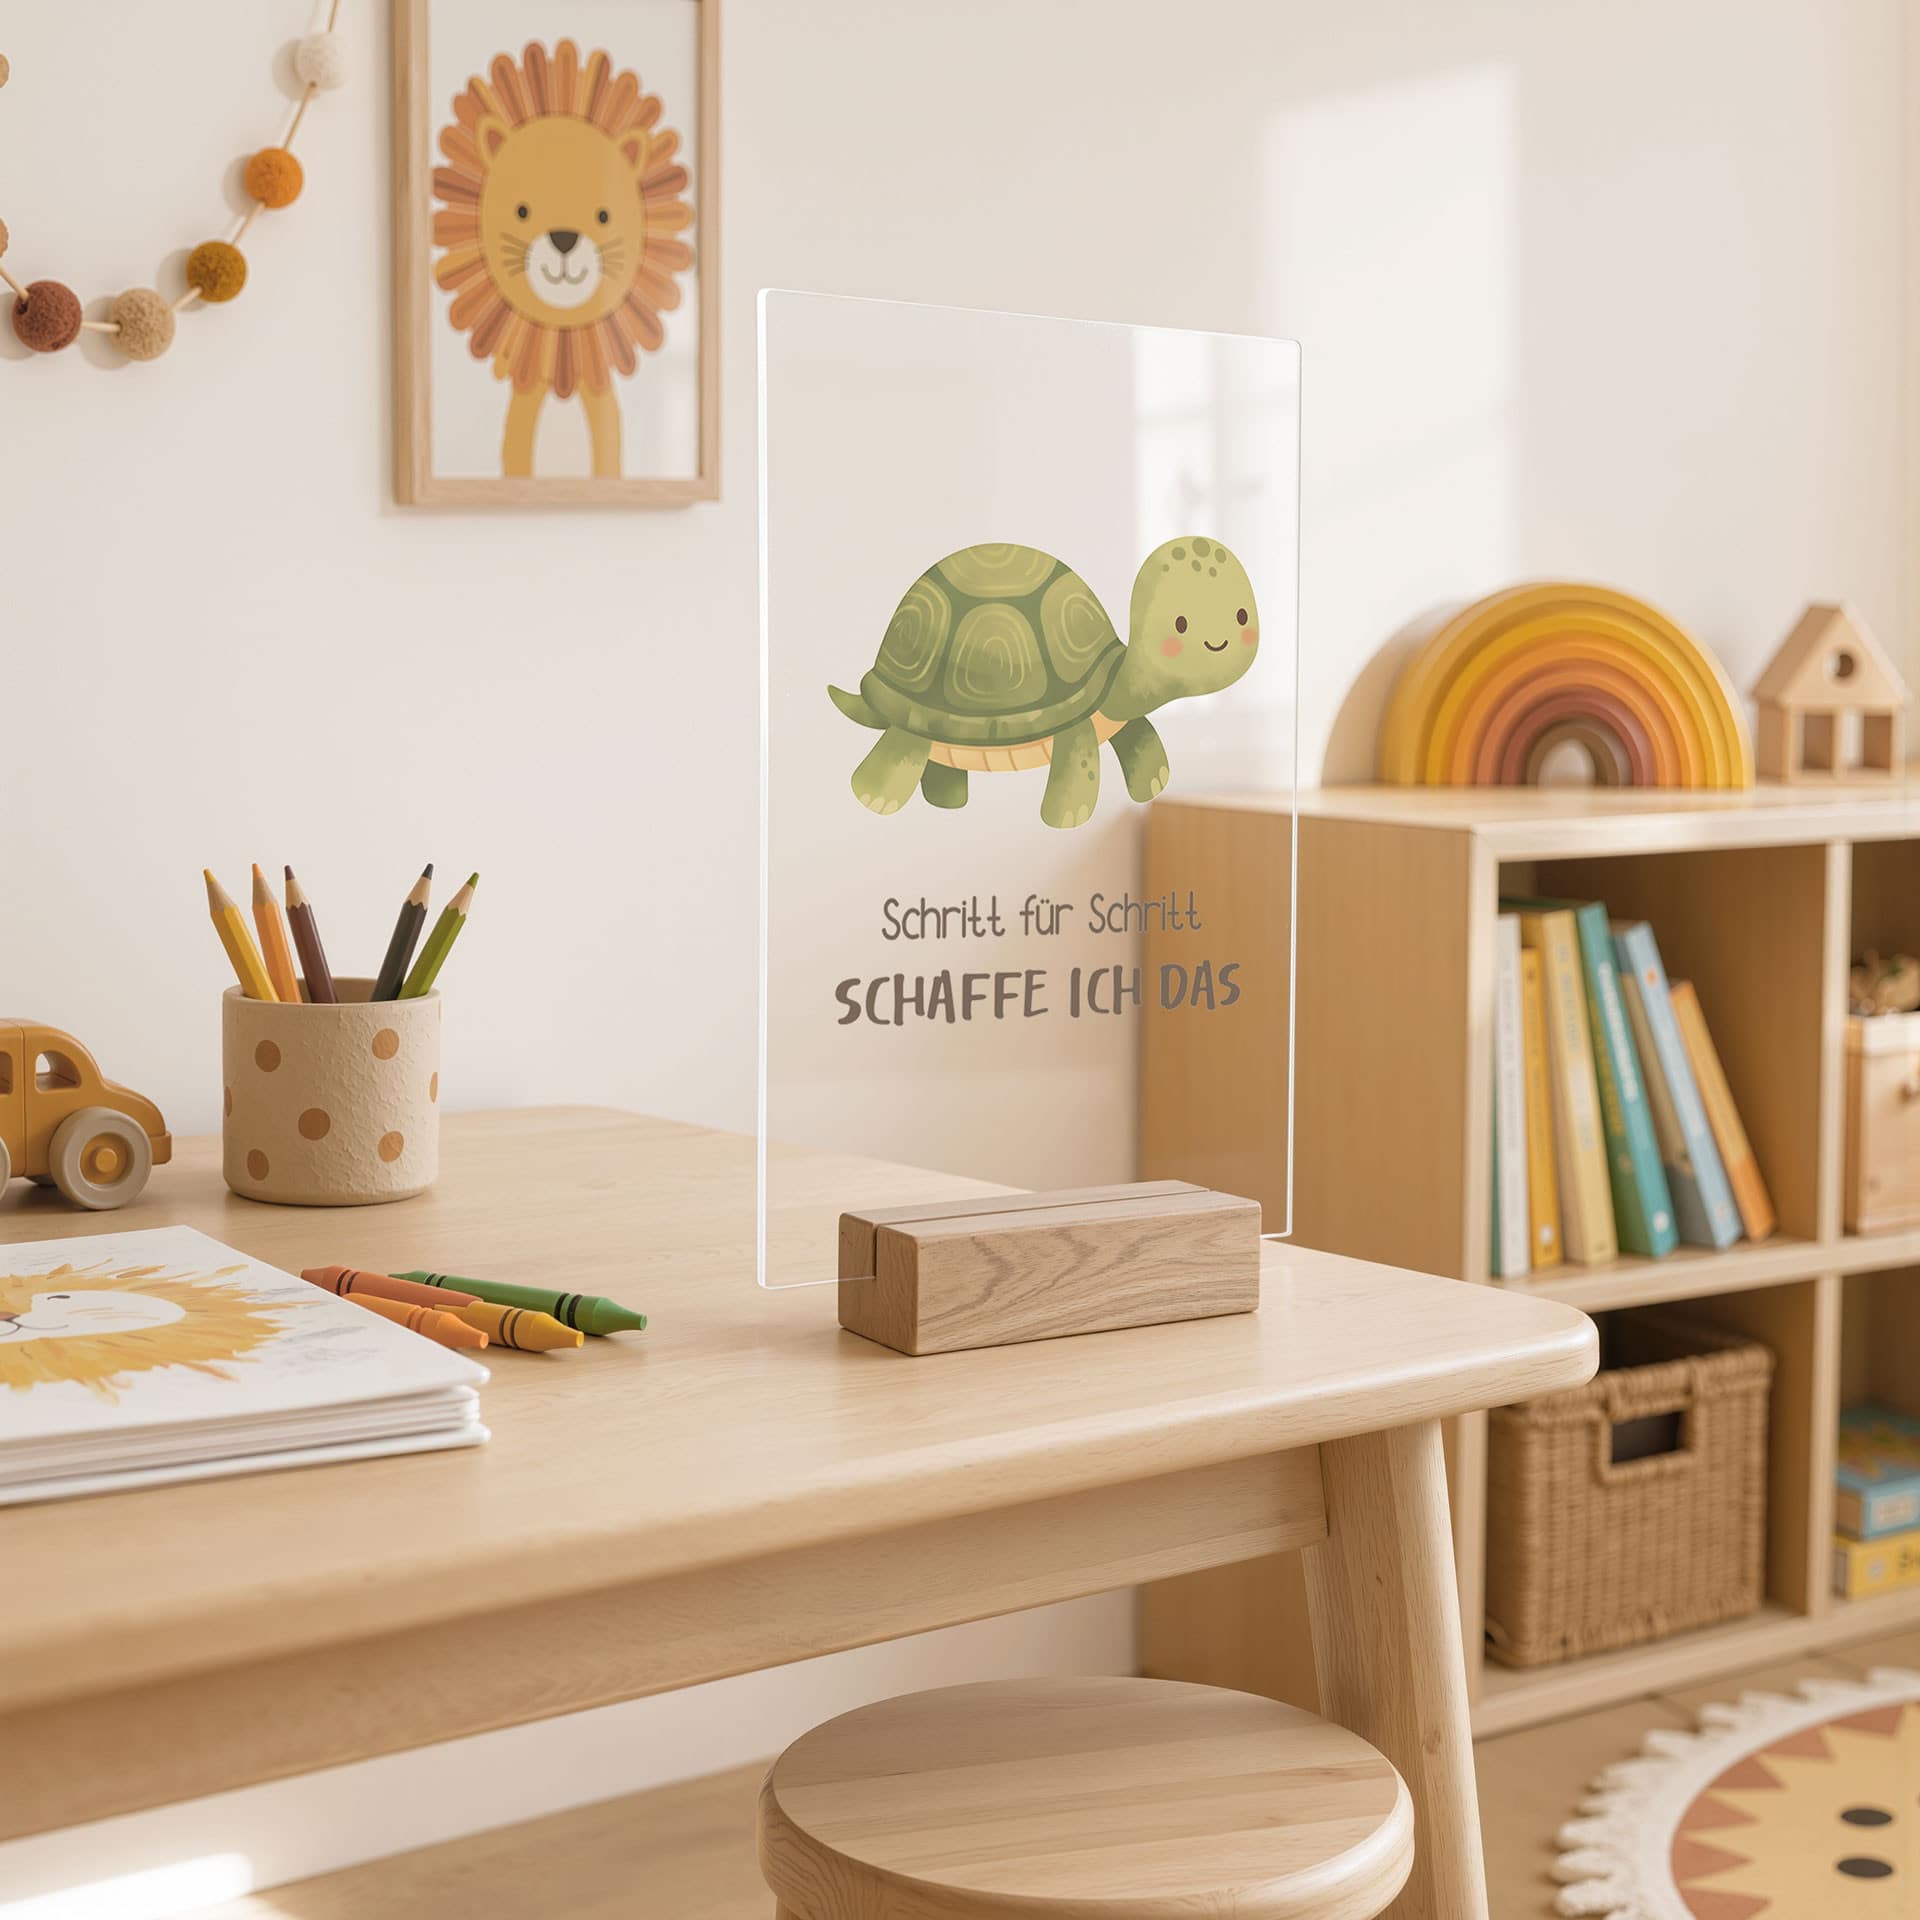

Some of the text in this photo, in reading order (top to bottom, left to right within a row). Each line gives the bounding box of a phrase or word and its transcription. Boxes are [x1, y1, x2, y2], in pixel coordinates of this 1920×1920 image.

[881, 891, 1202, 940] Schritt für Schritt
[835, 960, 1241, 1026] SCHAFFE ICH DAS
